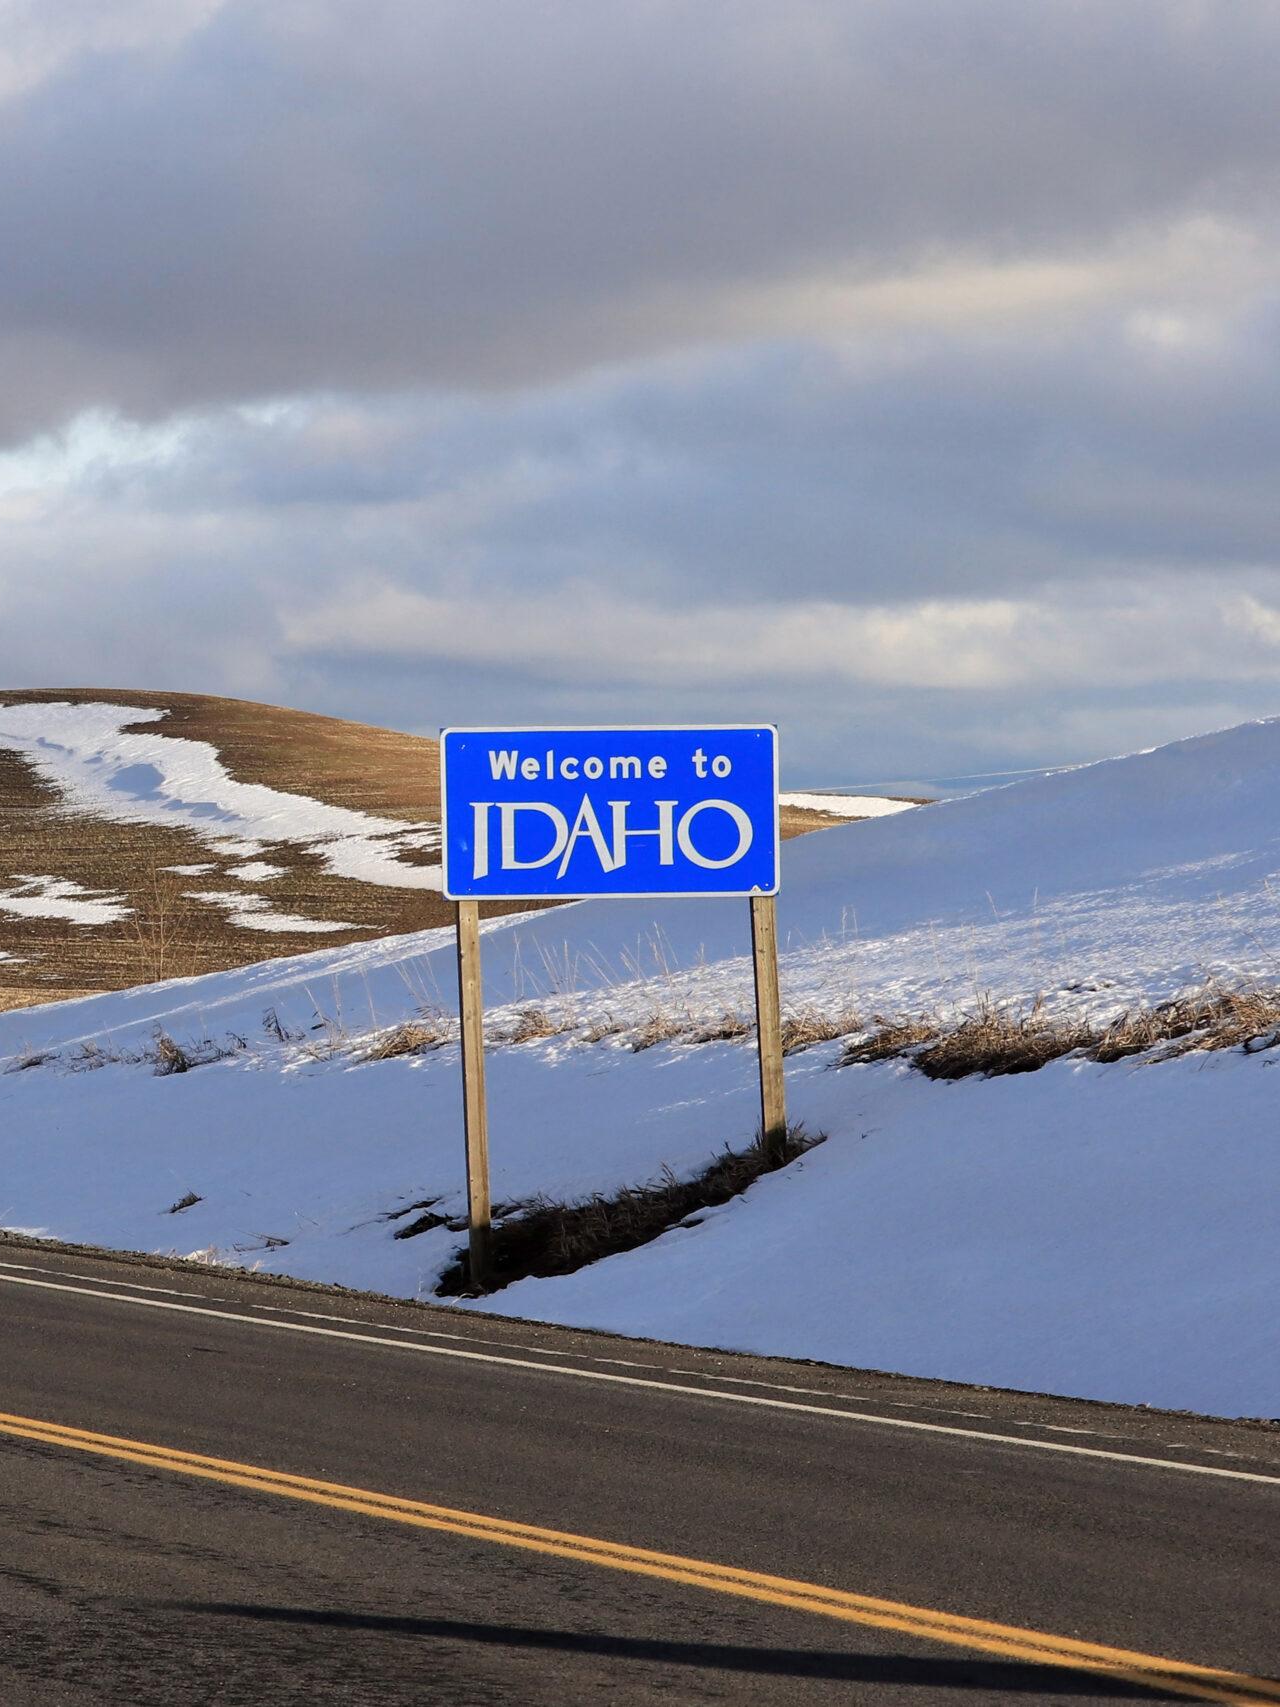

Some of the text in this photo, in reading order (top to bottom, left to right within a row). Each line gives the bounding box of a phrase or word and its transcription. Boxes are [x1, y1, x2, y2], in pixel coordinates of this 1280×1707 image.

[488, 747, 732, 780] Welcome to
[469, 793, 753, 880] IDAHO
